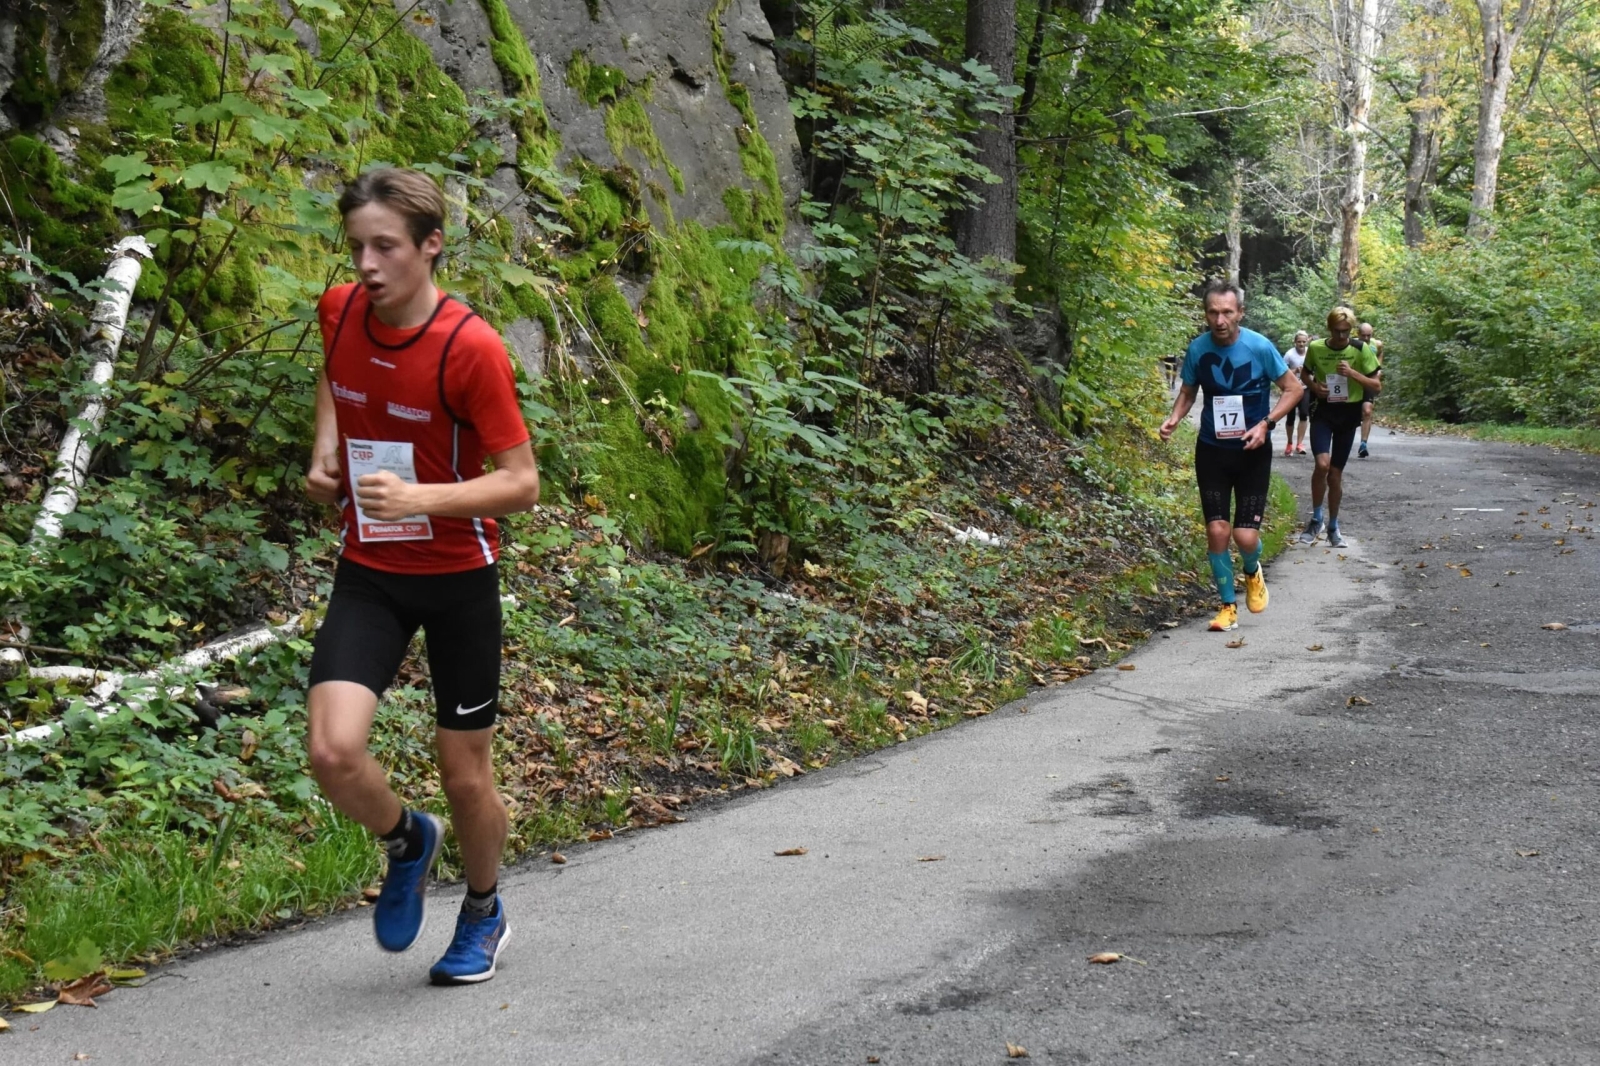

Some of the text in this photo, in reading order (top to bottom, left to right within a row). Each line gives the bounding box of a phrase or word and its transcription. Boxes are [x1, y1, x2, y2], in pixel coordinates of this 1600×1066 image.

[1334, 385, 1341, 394] 8
[1220, 412, 1238, 426] 17
[351, 450, 374, 461] CUP
[405, 524, 422, 532] CUP
